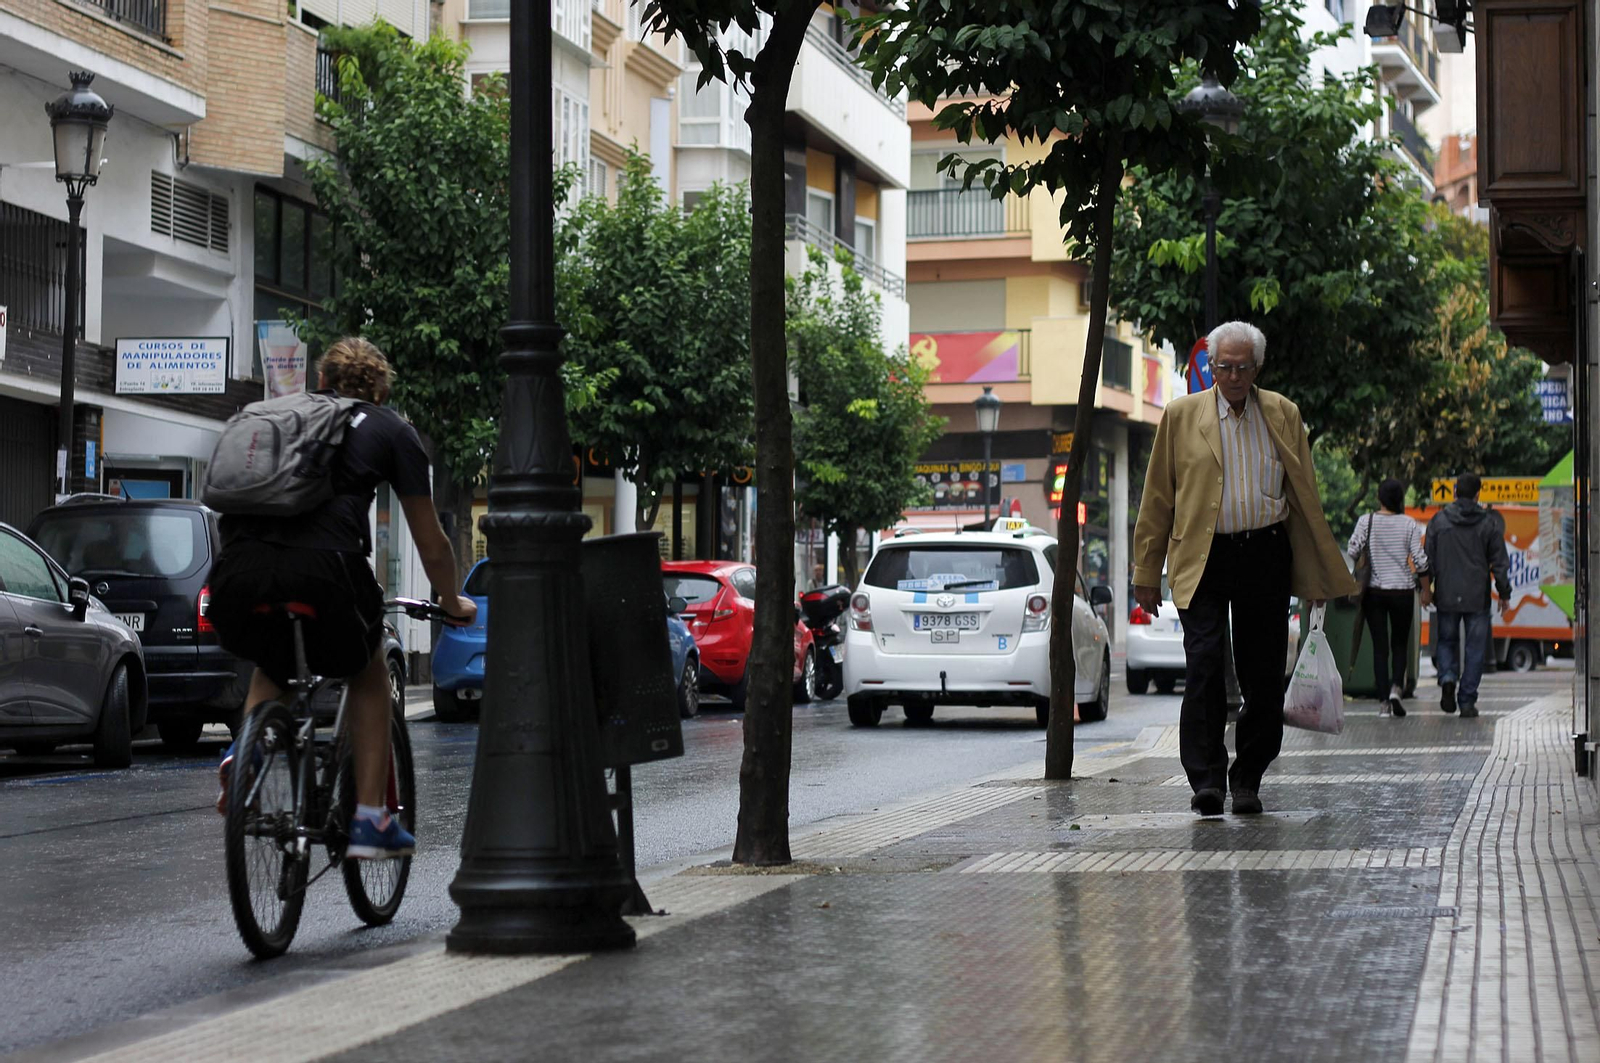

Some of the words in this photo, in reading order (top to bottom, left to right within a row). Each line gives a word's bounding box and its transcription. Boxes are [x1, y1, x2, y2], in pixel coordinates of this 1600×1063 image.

[138, 342, 184, 350] CURSOS
[190, 342, 206, 350] DE
[121, 352, 222, 360] MANIPULADORES
[127, 362, 142, 370] DE
[149, 362, 216, 370] ALIMENTOS
[959, 462, 982, 473] BINGO
[1481, 480, 1508, 492] Casa
[922, 614, 951, 626] 9378
[954, 614, 978, 626] GSS
[934, 630, 956, 641] SP
[997, 637, 1008, 650] B
